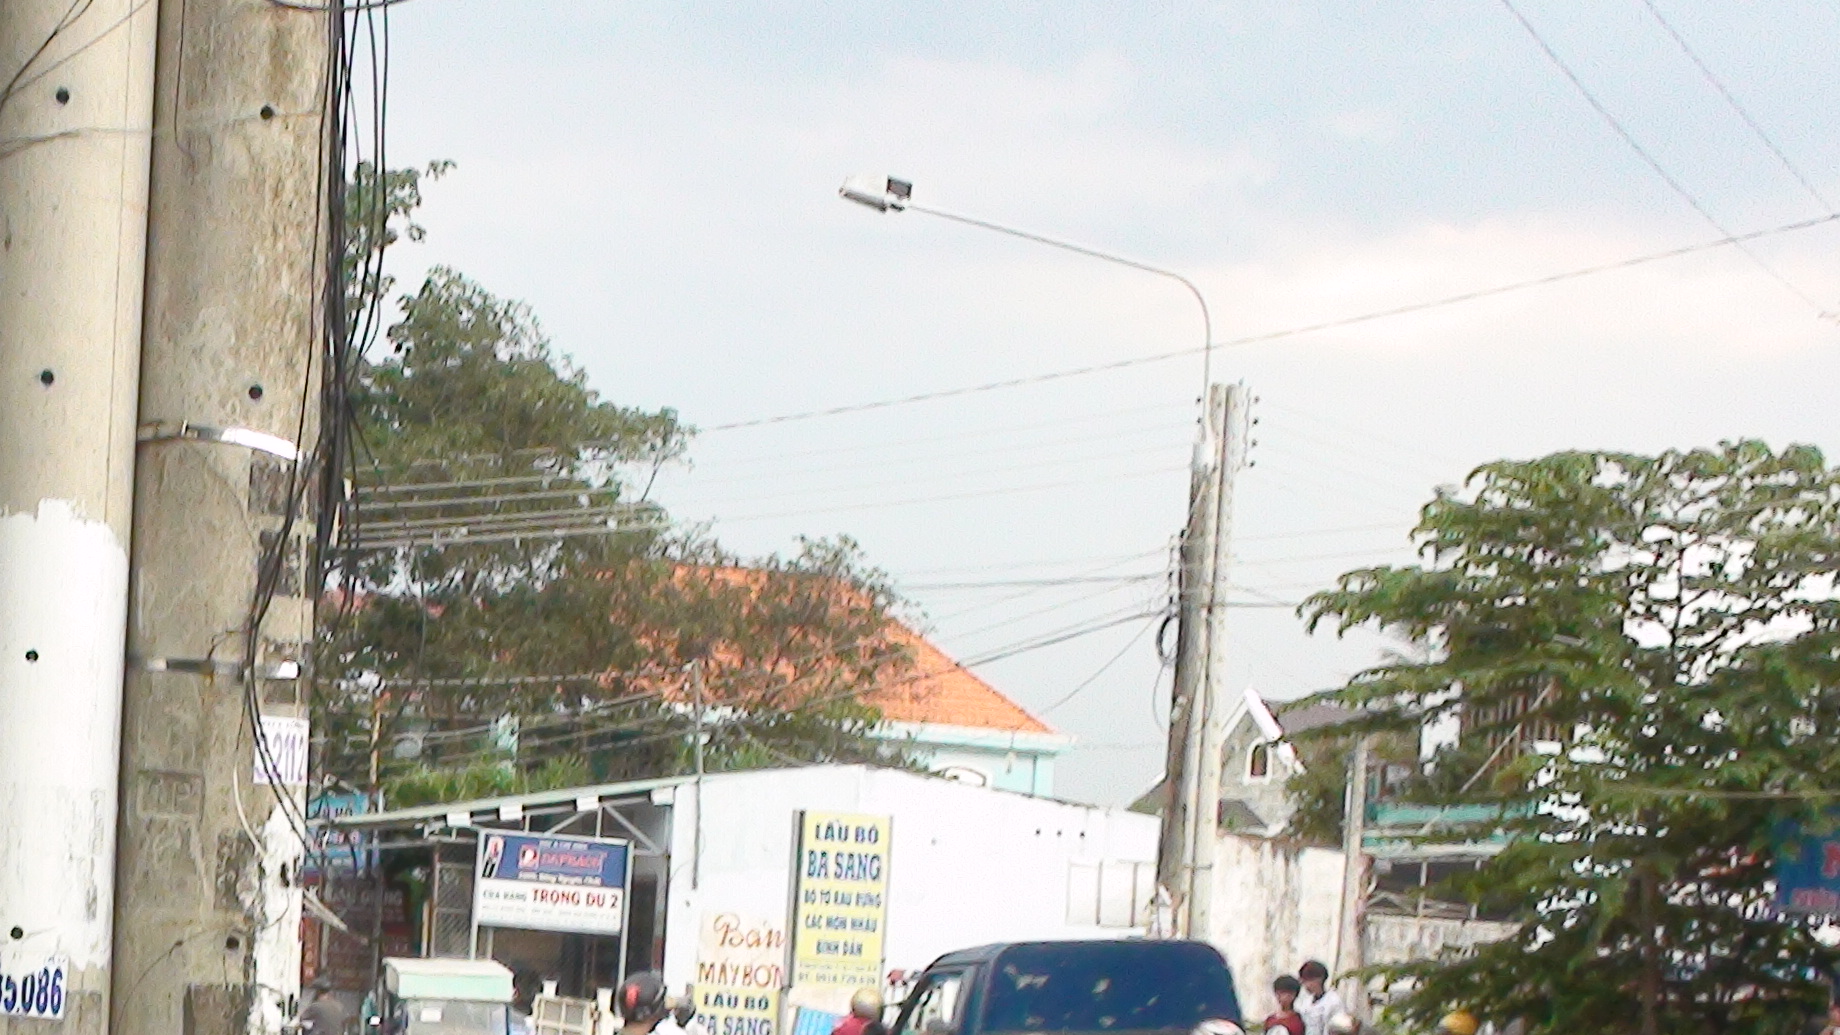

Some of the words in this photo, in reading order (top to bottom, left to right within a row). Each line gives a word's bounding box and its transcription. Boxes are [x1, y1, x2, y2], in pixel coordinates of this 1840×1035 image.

[807, 849, 829, 879] BA
[834, 851, 881, 882] SANG
[610, 893, 619, 909] 2
